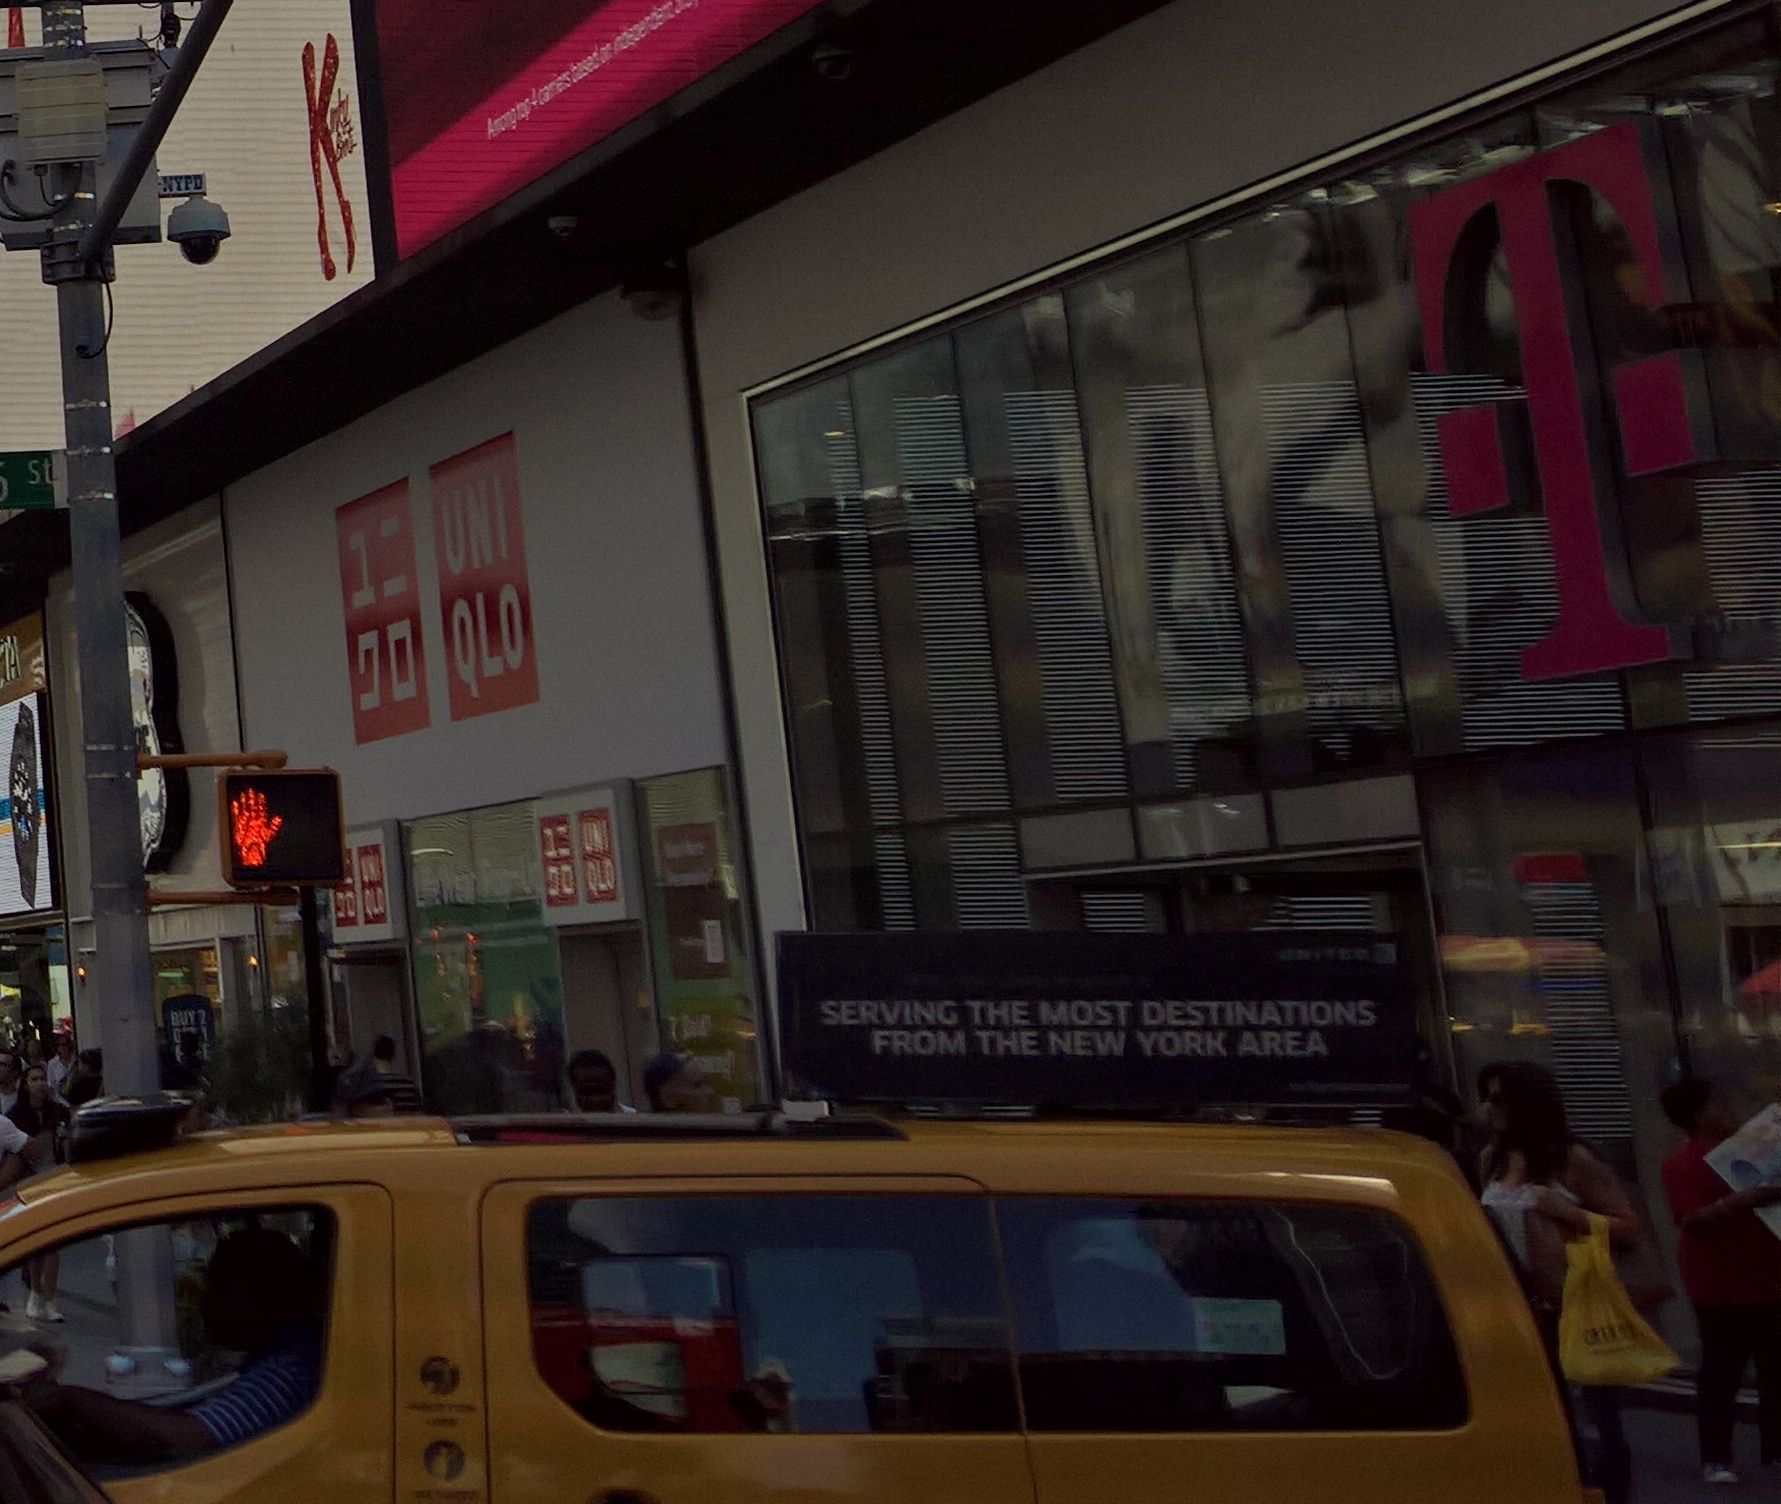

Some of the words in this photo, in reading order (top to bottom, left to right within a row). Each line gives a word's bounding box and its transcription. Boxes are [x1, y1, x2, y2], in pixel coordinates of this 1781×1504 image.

[162, 175, 203, 193] NYPD
[1407, 121, 1696, 683] T
[28, 455, 55, 485] St
[442, 447, 515, 570] UNI
[451, 579, 526, 700] QLO
[819, 998, 959, 1028] SERVING
[967, 998, 1031, 1027] THE
[1039, 999, 1132, 1027] MOST
[1141, 998, 1377, 1027] DESTINATIONS
[871, 1029, 967, 1058] FROM
[976, 1030, 1040, 1057] THE
[1048, 1029, 1126, 1057] NEW
[1135, 1029, 1228, 1057] YORK
[1237, 1029, 1329, 1057] AREA
